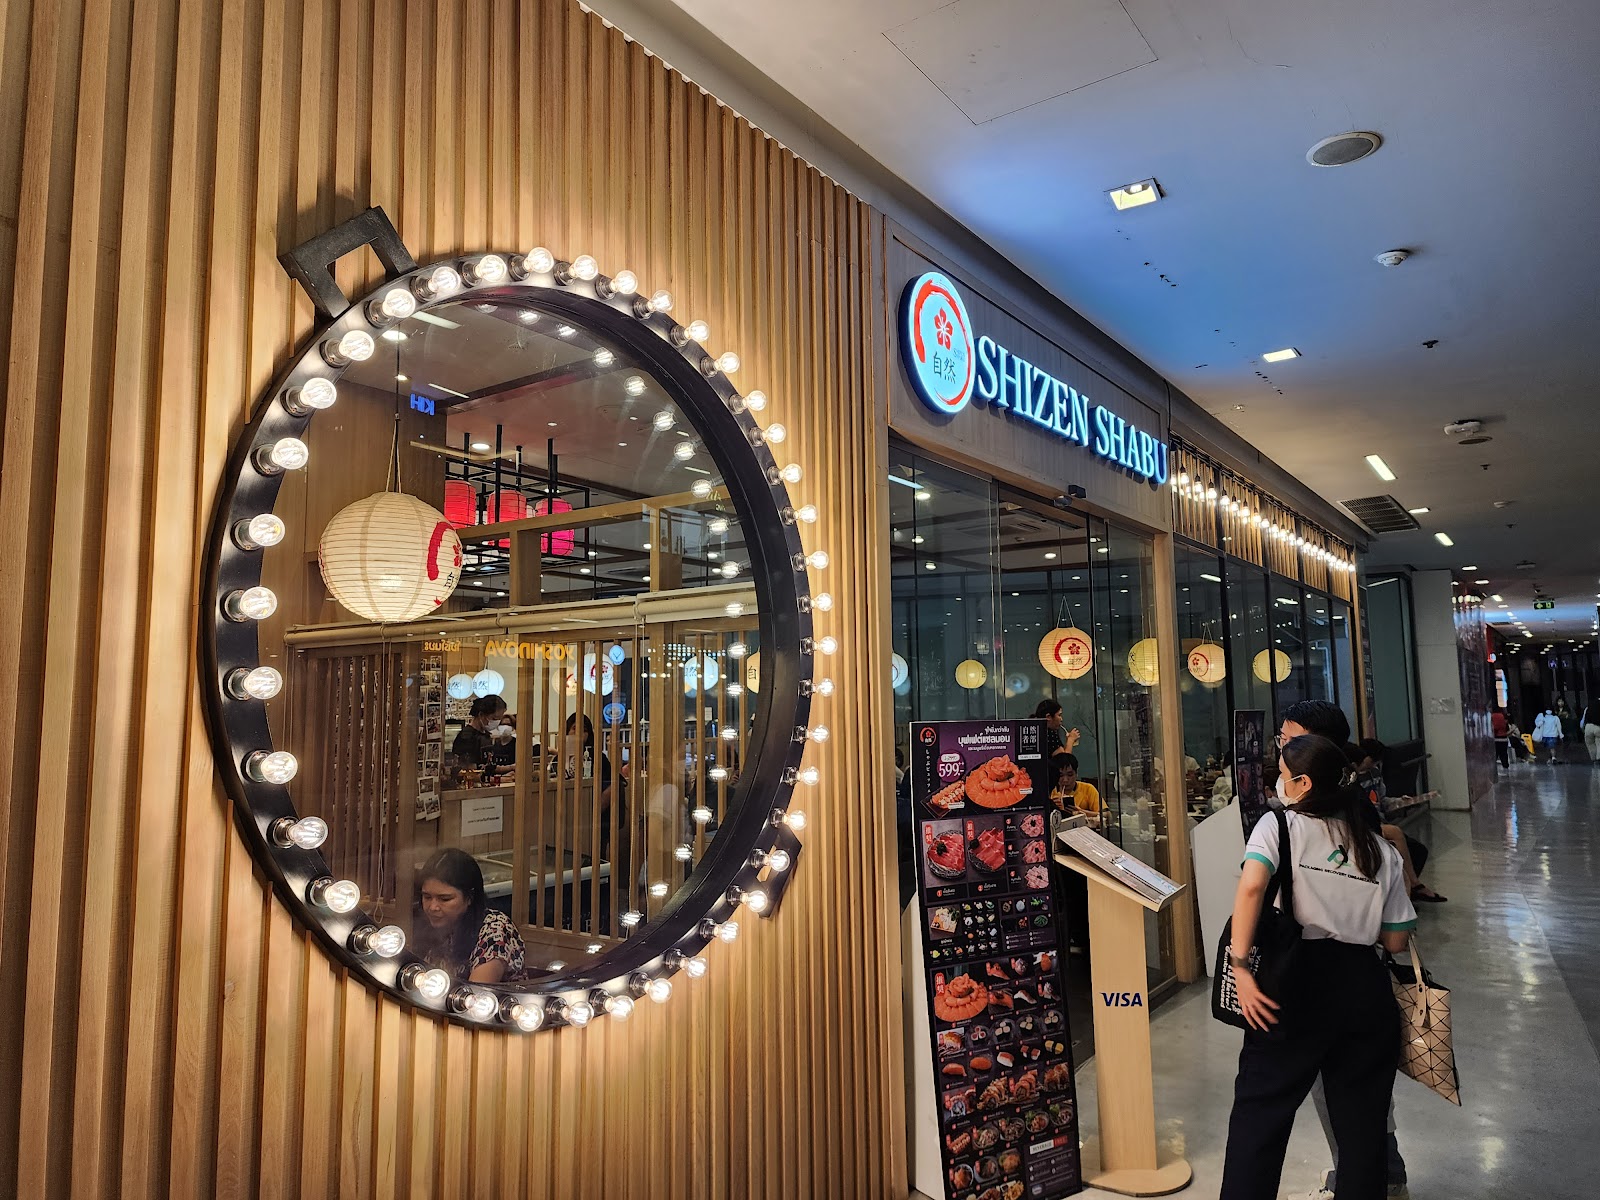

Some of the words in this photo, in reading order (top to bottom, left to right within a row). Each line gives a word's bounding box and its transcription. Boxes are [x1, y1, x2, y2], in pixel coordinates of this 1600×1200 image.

[933, 351, 956, 384] 自然
[978, 336, 1089, 447] SHIZEN
[1095, 405, 1168, 484] SHABU
[1100, 992, 1143, 1007] VISA
[1220, 974, 1228, 1009] Focused
